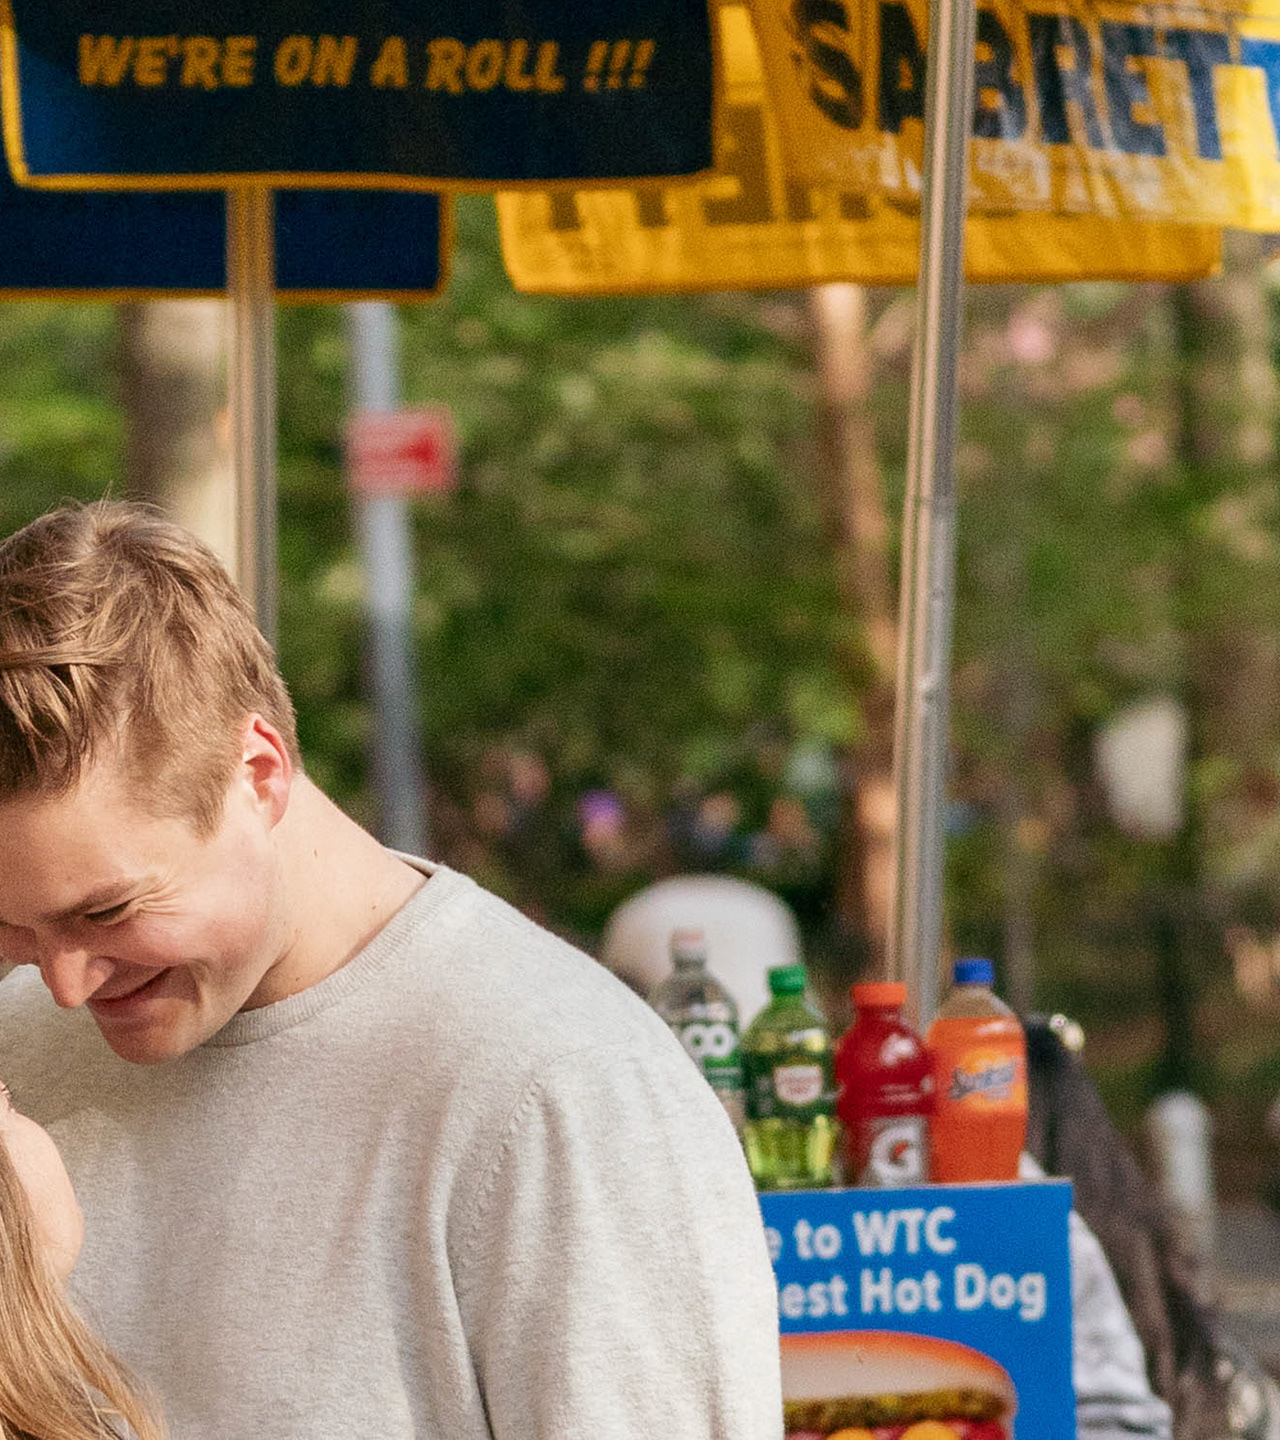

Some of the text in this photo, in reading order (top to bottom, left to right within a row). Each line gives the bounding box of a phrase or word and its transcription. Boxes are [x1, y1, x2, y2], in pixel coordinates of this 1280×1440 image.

[76, 34, 258, 90] WE'RE
[274, 35, 358, 88] ON
[371, 36, 410, 88] A
[425, 37, 566, 94] ROLL
[793, 1219, 842, 1260] to
[853, 1206, 957, 1257] WTC
[779, 1263, 1047, 1322] est Hot Dog
